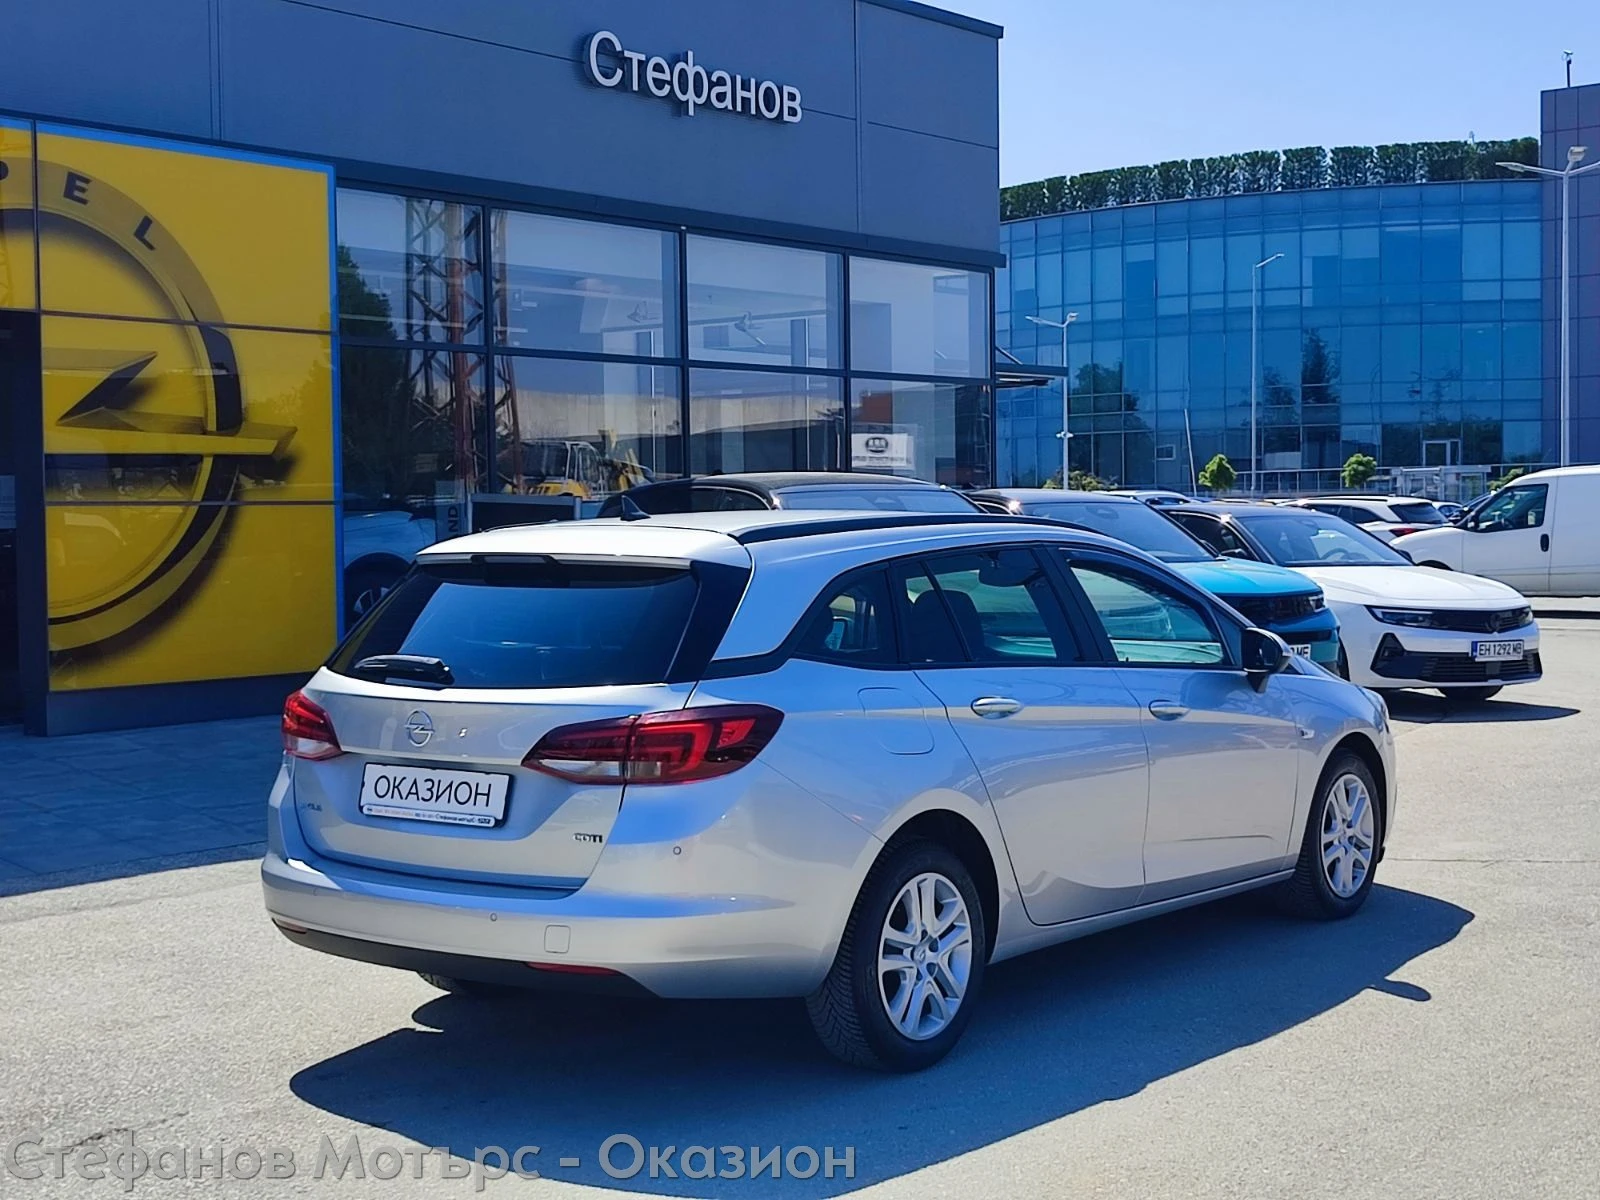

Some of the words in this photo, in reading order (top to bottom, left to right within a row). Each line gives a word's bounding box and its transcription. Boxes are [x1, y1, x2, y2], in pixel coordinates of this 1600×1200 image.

[589, 30, 803, 123] Стефанов
[1479, 644, 1491, 656] EH
[1493, 643, 1512, 656] 1292
[374, 774, 492, 807] ОКАЗИОН
